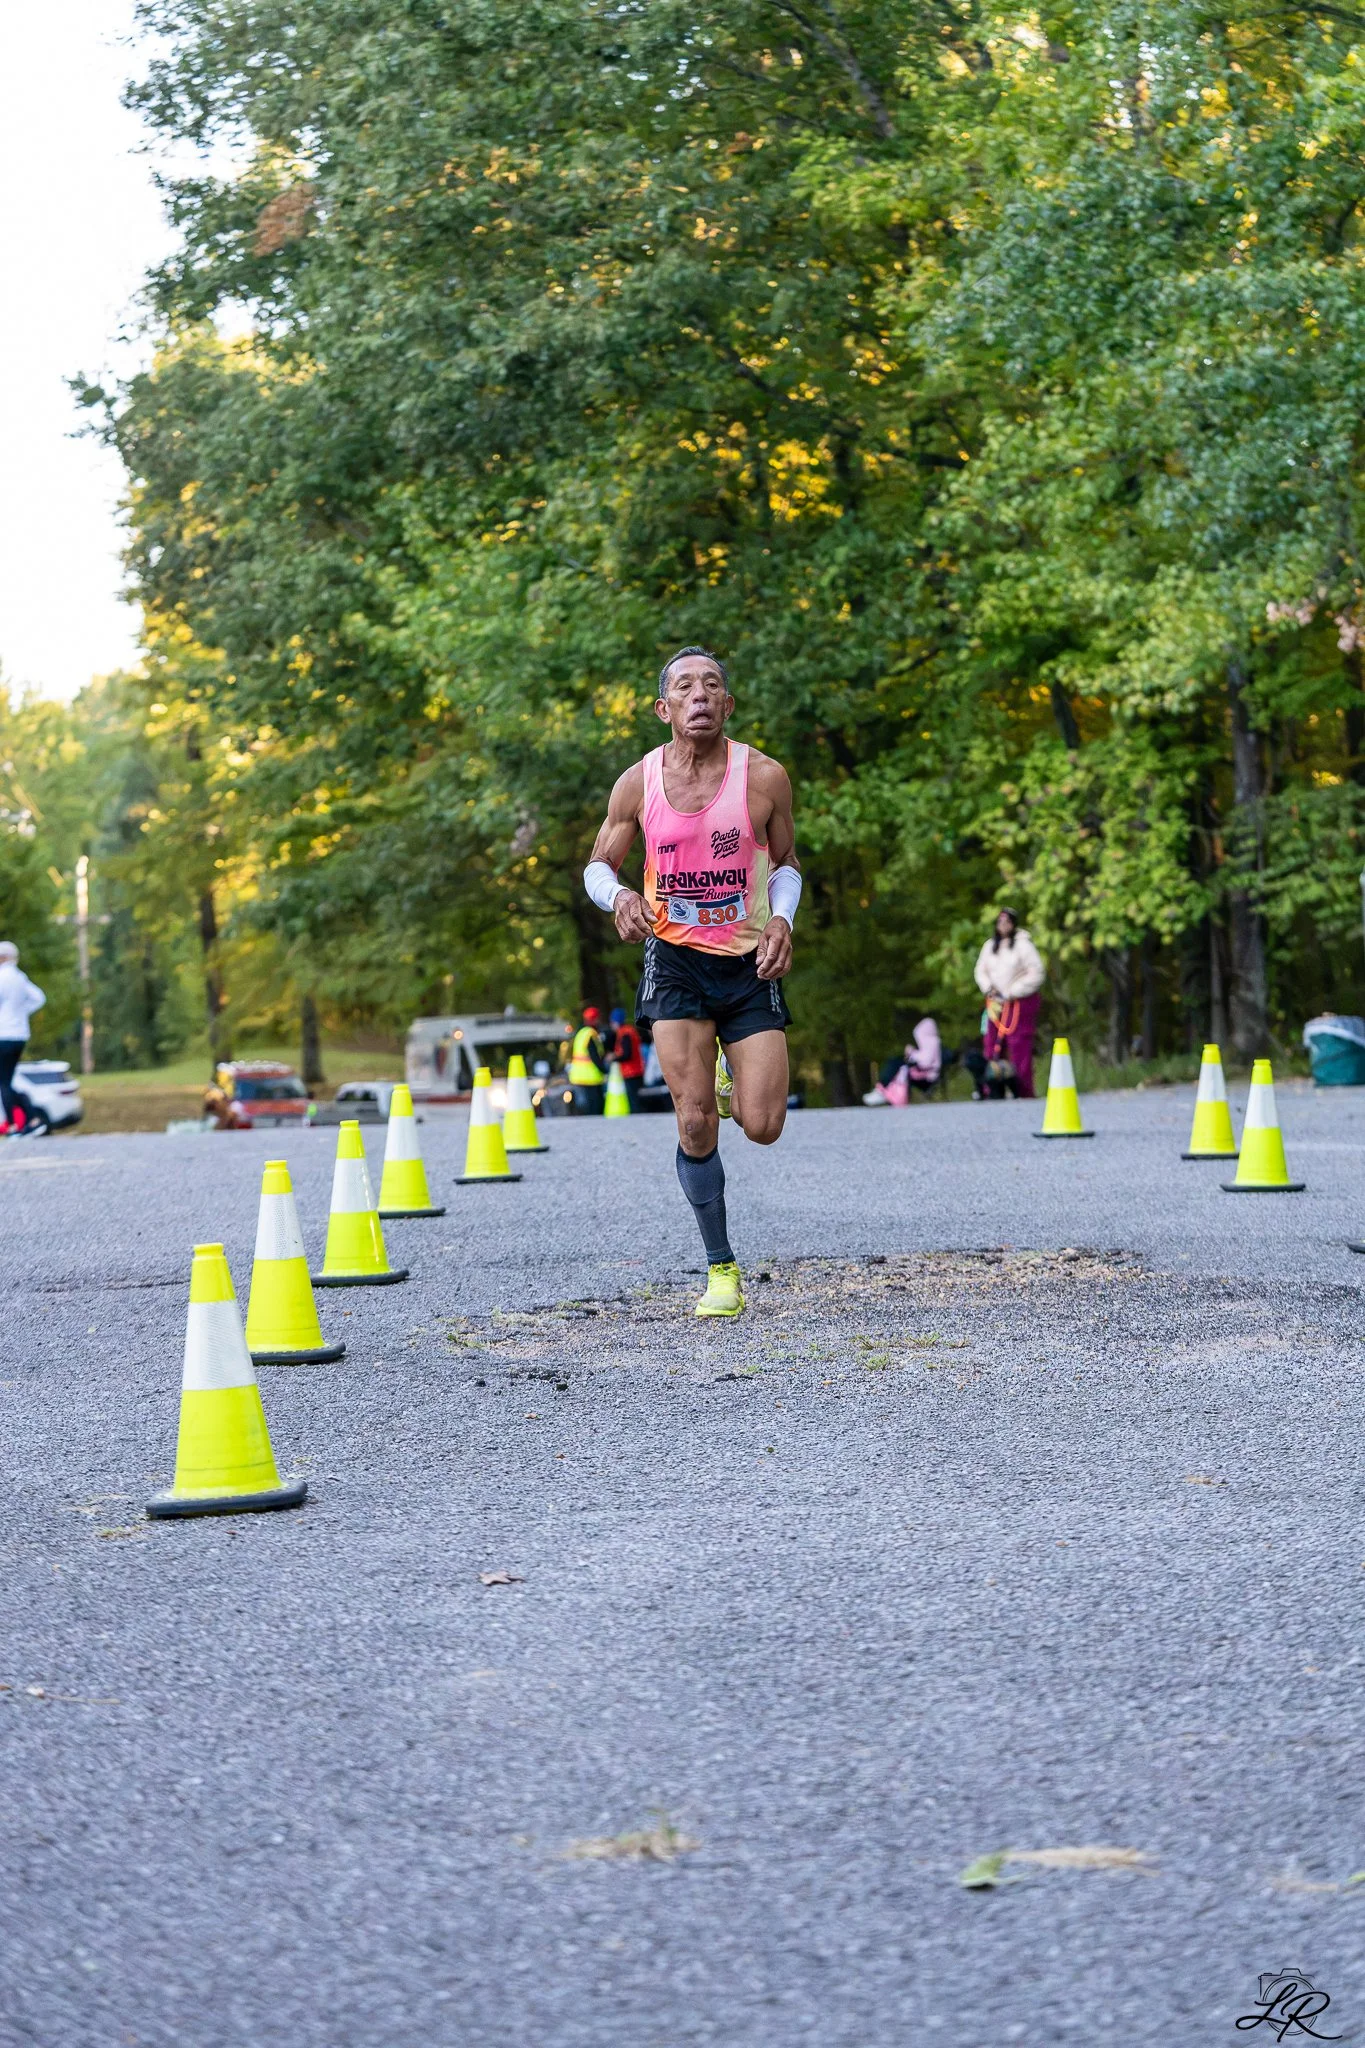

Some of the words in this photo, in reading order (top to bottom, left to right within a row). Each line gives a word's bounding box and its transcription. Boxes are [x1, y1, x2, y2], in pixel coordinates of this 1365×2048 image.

[711, 827, 740, 848] Party
[713, 841, 740, 859] Pace
[697, 904, 738, 925] 830
